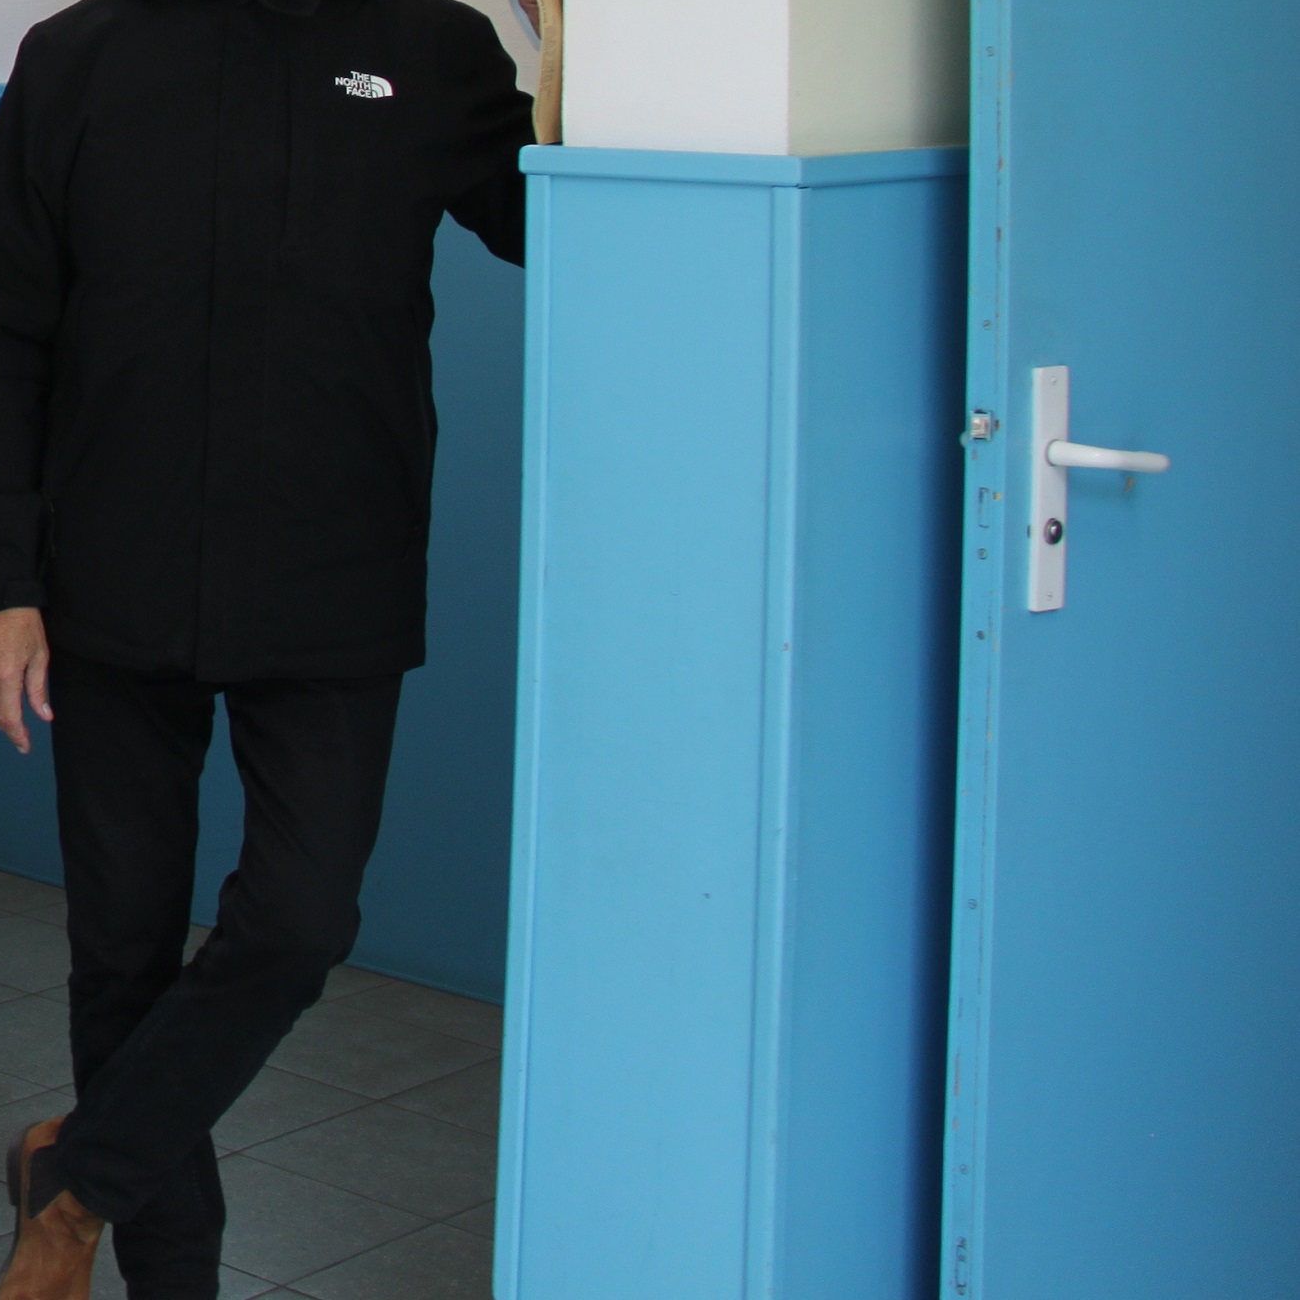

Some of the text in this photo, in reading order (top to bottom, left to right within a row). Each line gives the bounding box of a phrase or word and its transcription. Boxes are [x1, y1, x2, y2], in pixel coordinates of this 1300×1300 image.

[350, 71, 370, 82] THE
[334, 77, 371, 90] NORTH
[346, 86, 372, 98] FACE
